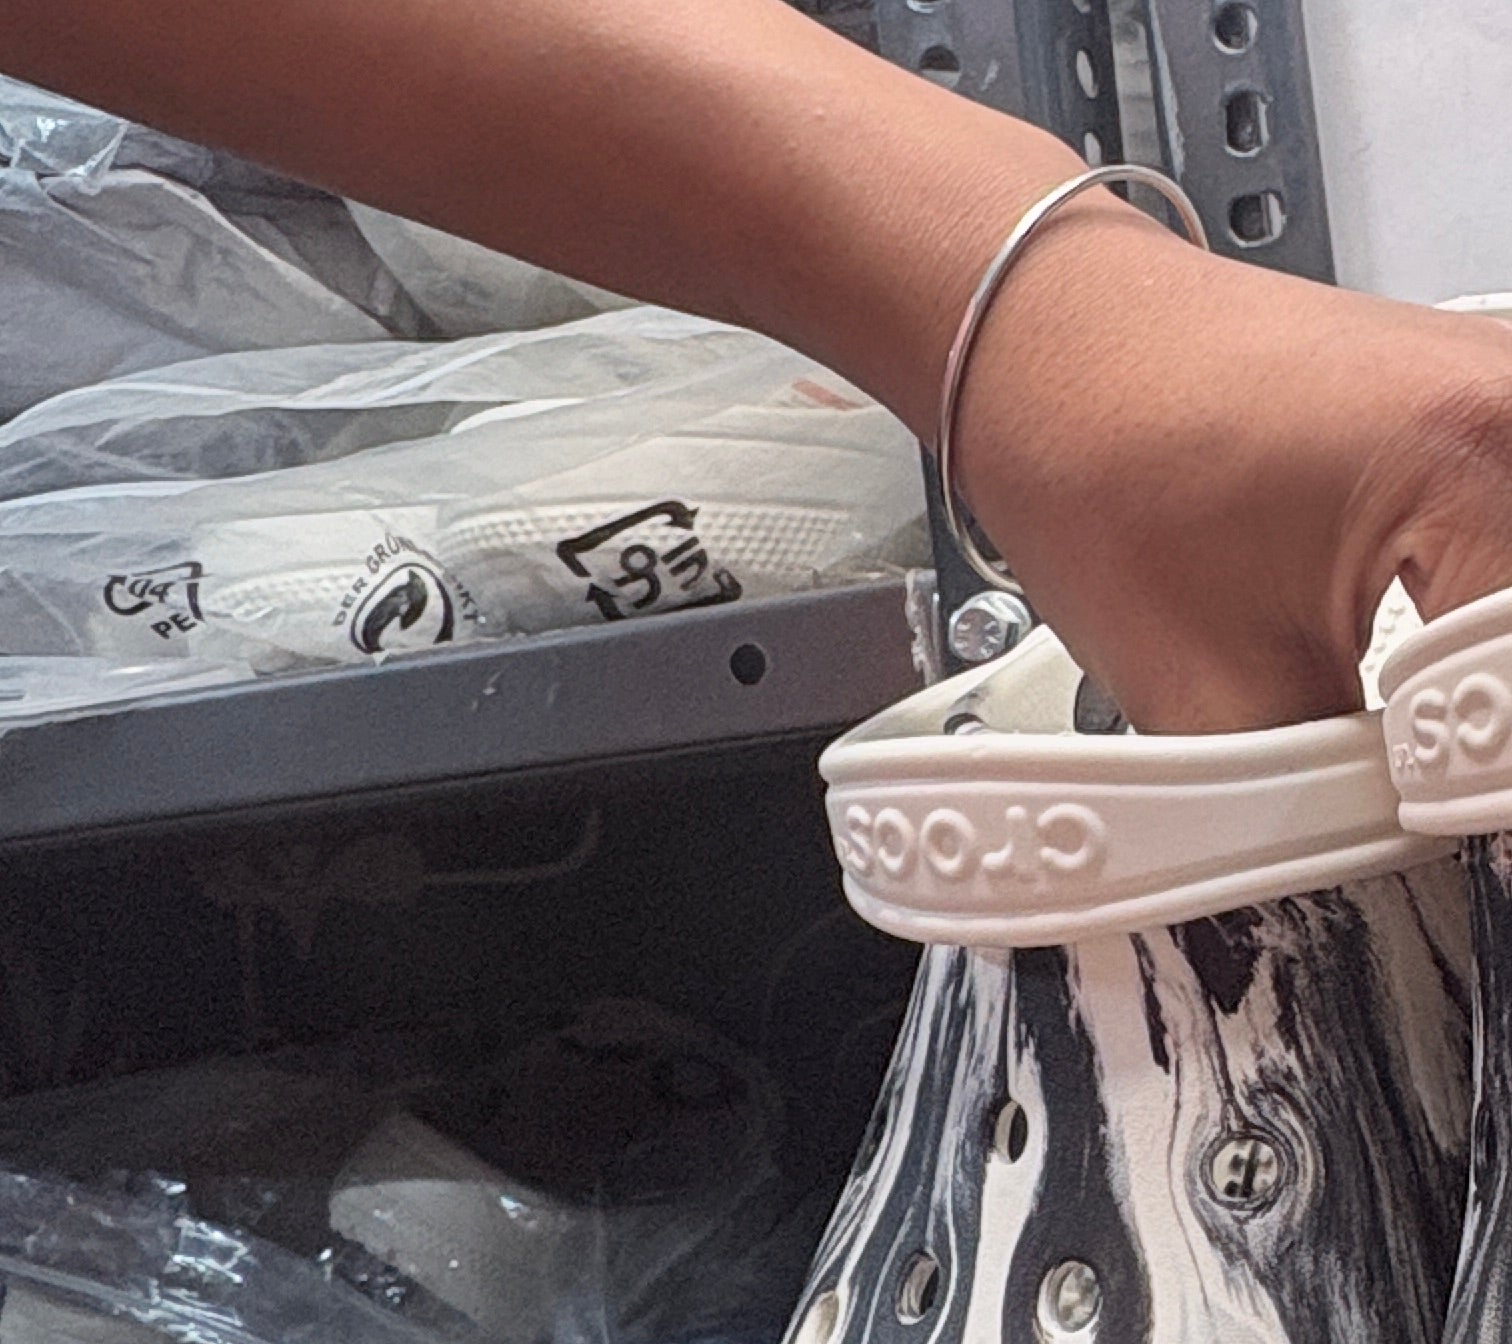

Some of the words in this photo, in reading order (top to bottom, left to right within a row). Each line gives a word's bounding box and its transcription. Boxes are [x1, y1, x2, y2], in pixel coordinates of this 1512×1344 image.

[332, 577, 368, 626] DER
[613, 536, 708, 610] プラ
[845, 804, 1106, 872] crocs
